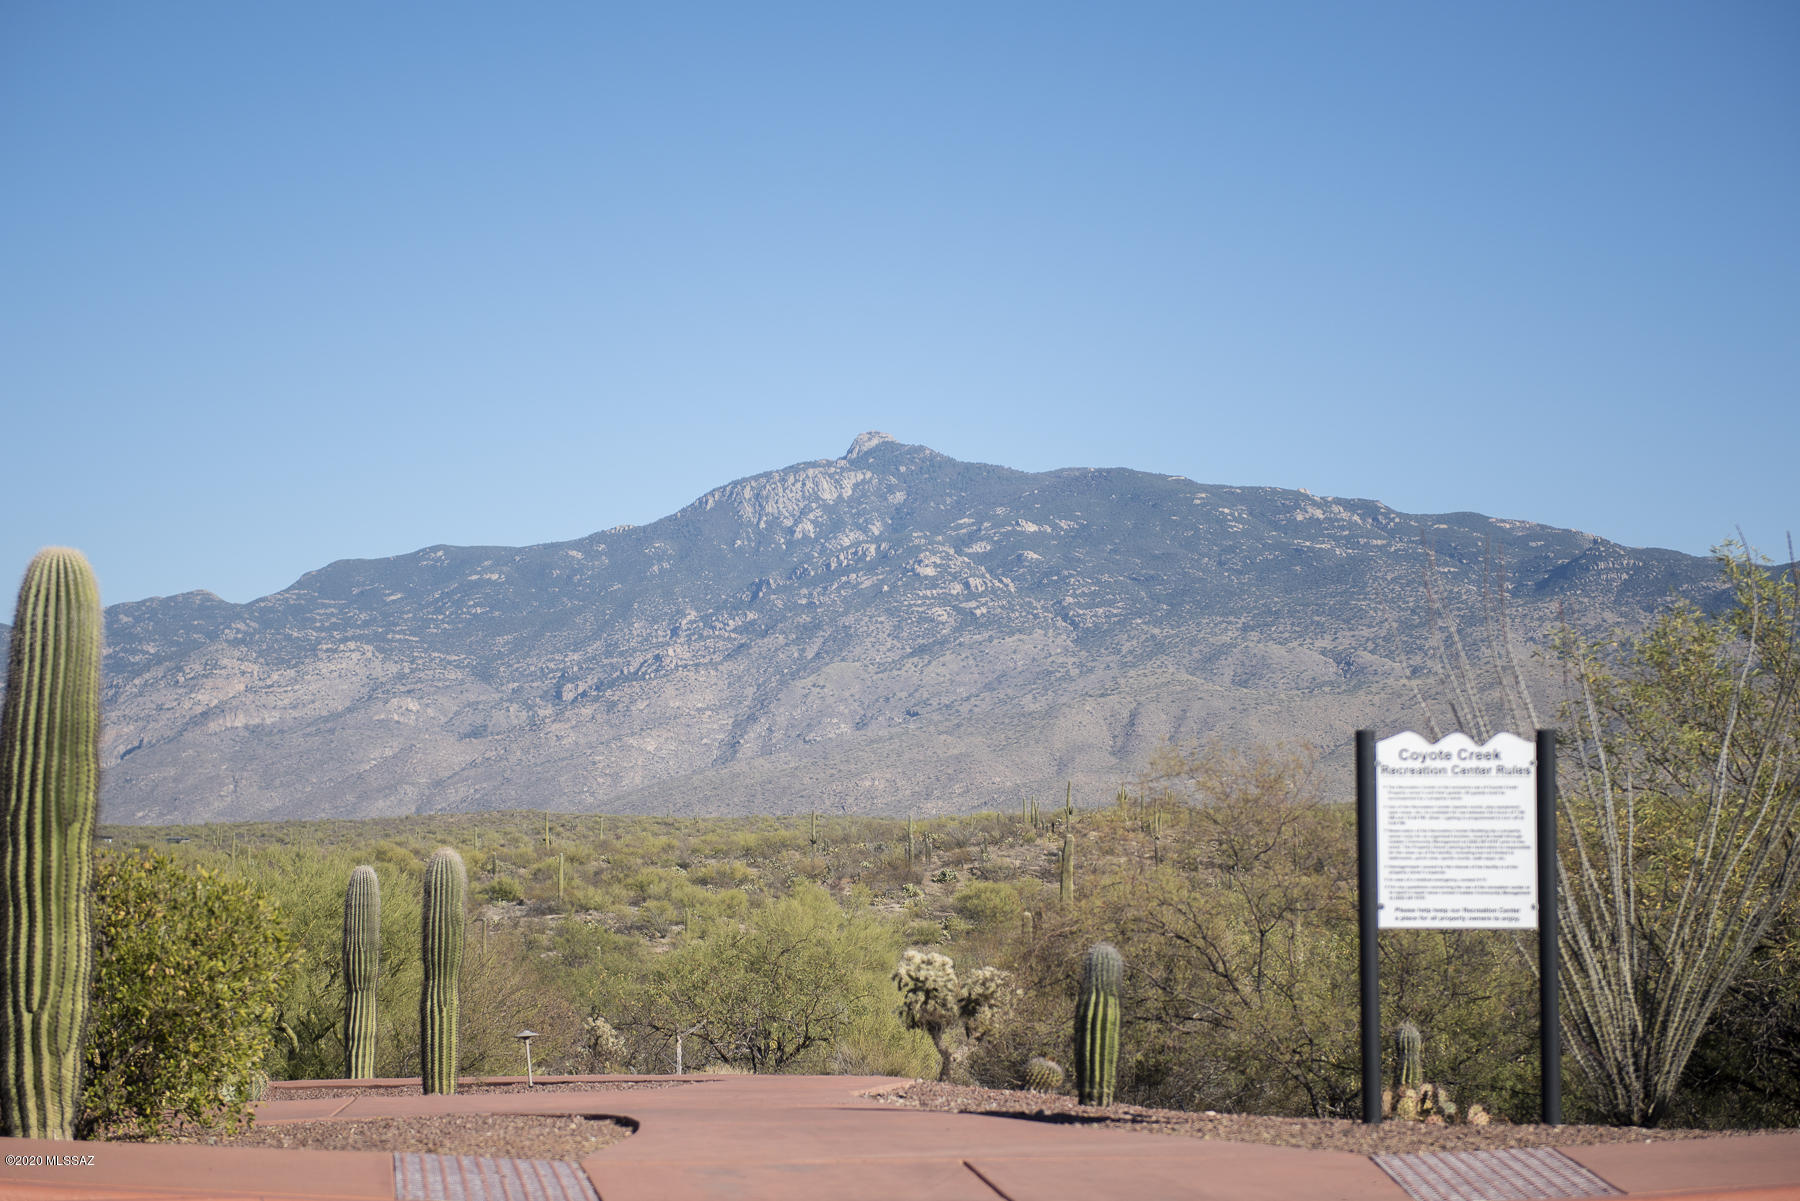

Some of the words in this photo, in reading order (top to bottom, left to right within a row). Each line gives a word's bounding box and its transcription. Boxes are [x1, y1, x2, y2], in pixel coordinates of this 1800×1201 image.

[1398, 748, 1452, 763] Coyote
[1457, 748, 1501, 761] Creek
[1380, 765, 1447, 775] Recreation
[1451, 765, 1492, 775] Center
[1496, 765, 1531, 775] Rules
